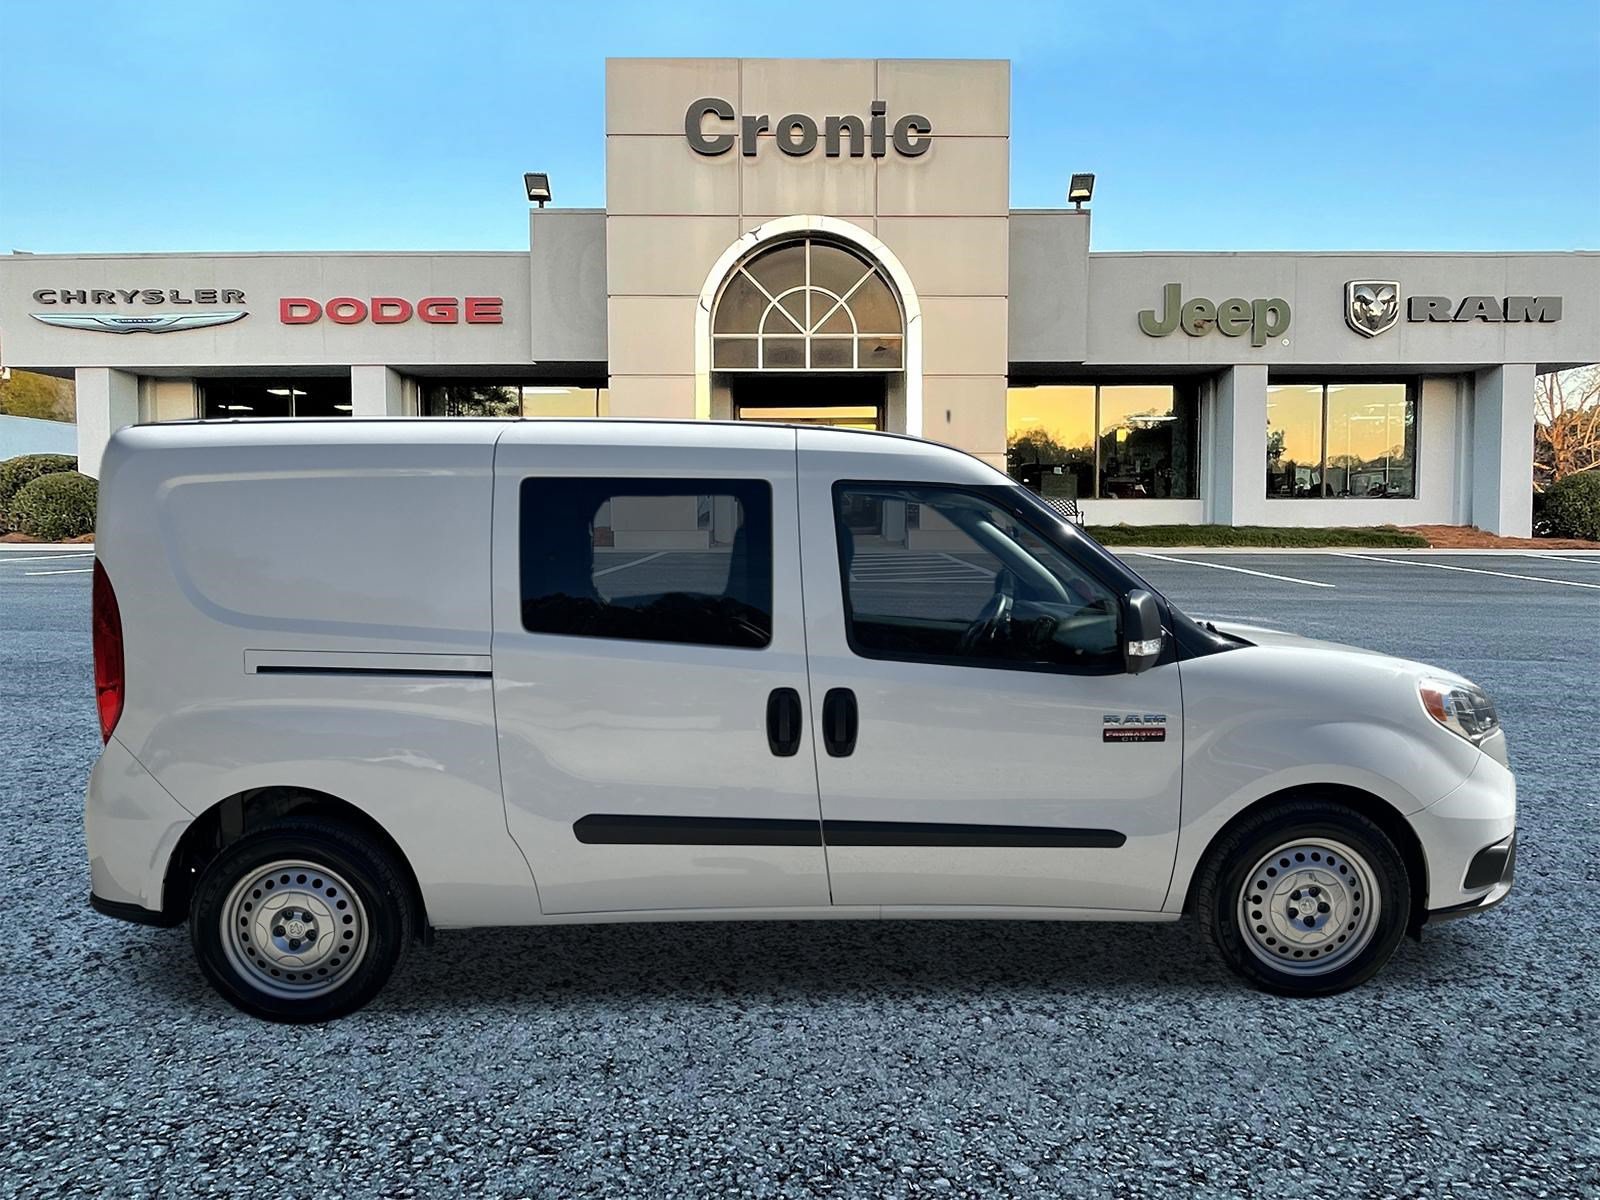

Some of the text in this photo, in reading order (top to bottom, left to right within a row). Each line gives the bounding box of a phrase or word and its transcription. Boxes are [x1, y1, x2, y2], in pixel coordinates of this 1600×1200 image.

[685, 97, 932, 157] Cronic
[32, 288, 247, 304] CHRYSLER
[1407, 296, 1562, 323] RAM
[279, 297, 504, 325] DODGE
[1138, 283, 1291, 347] Jeep
[1103, 714, 1167, 726] RAM
